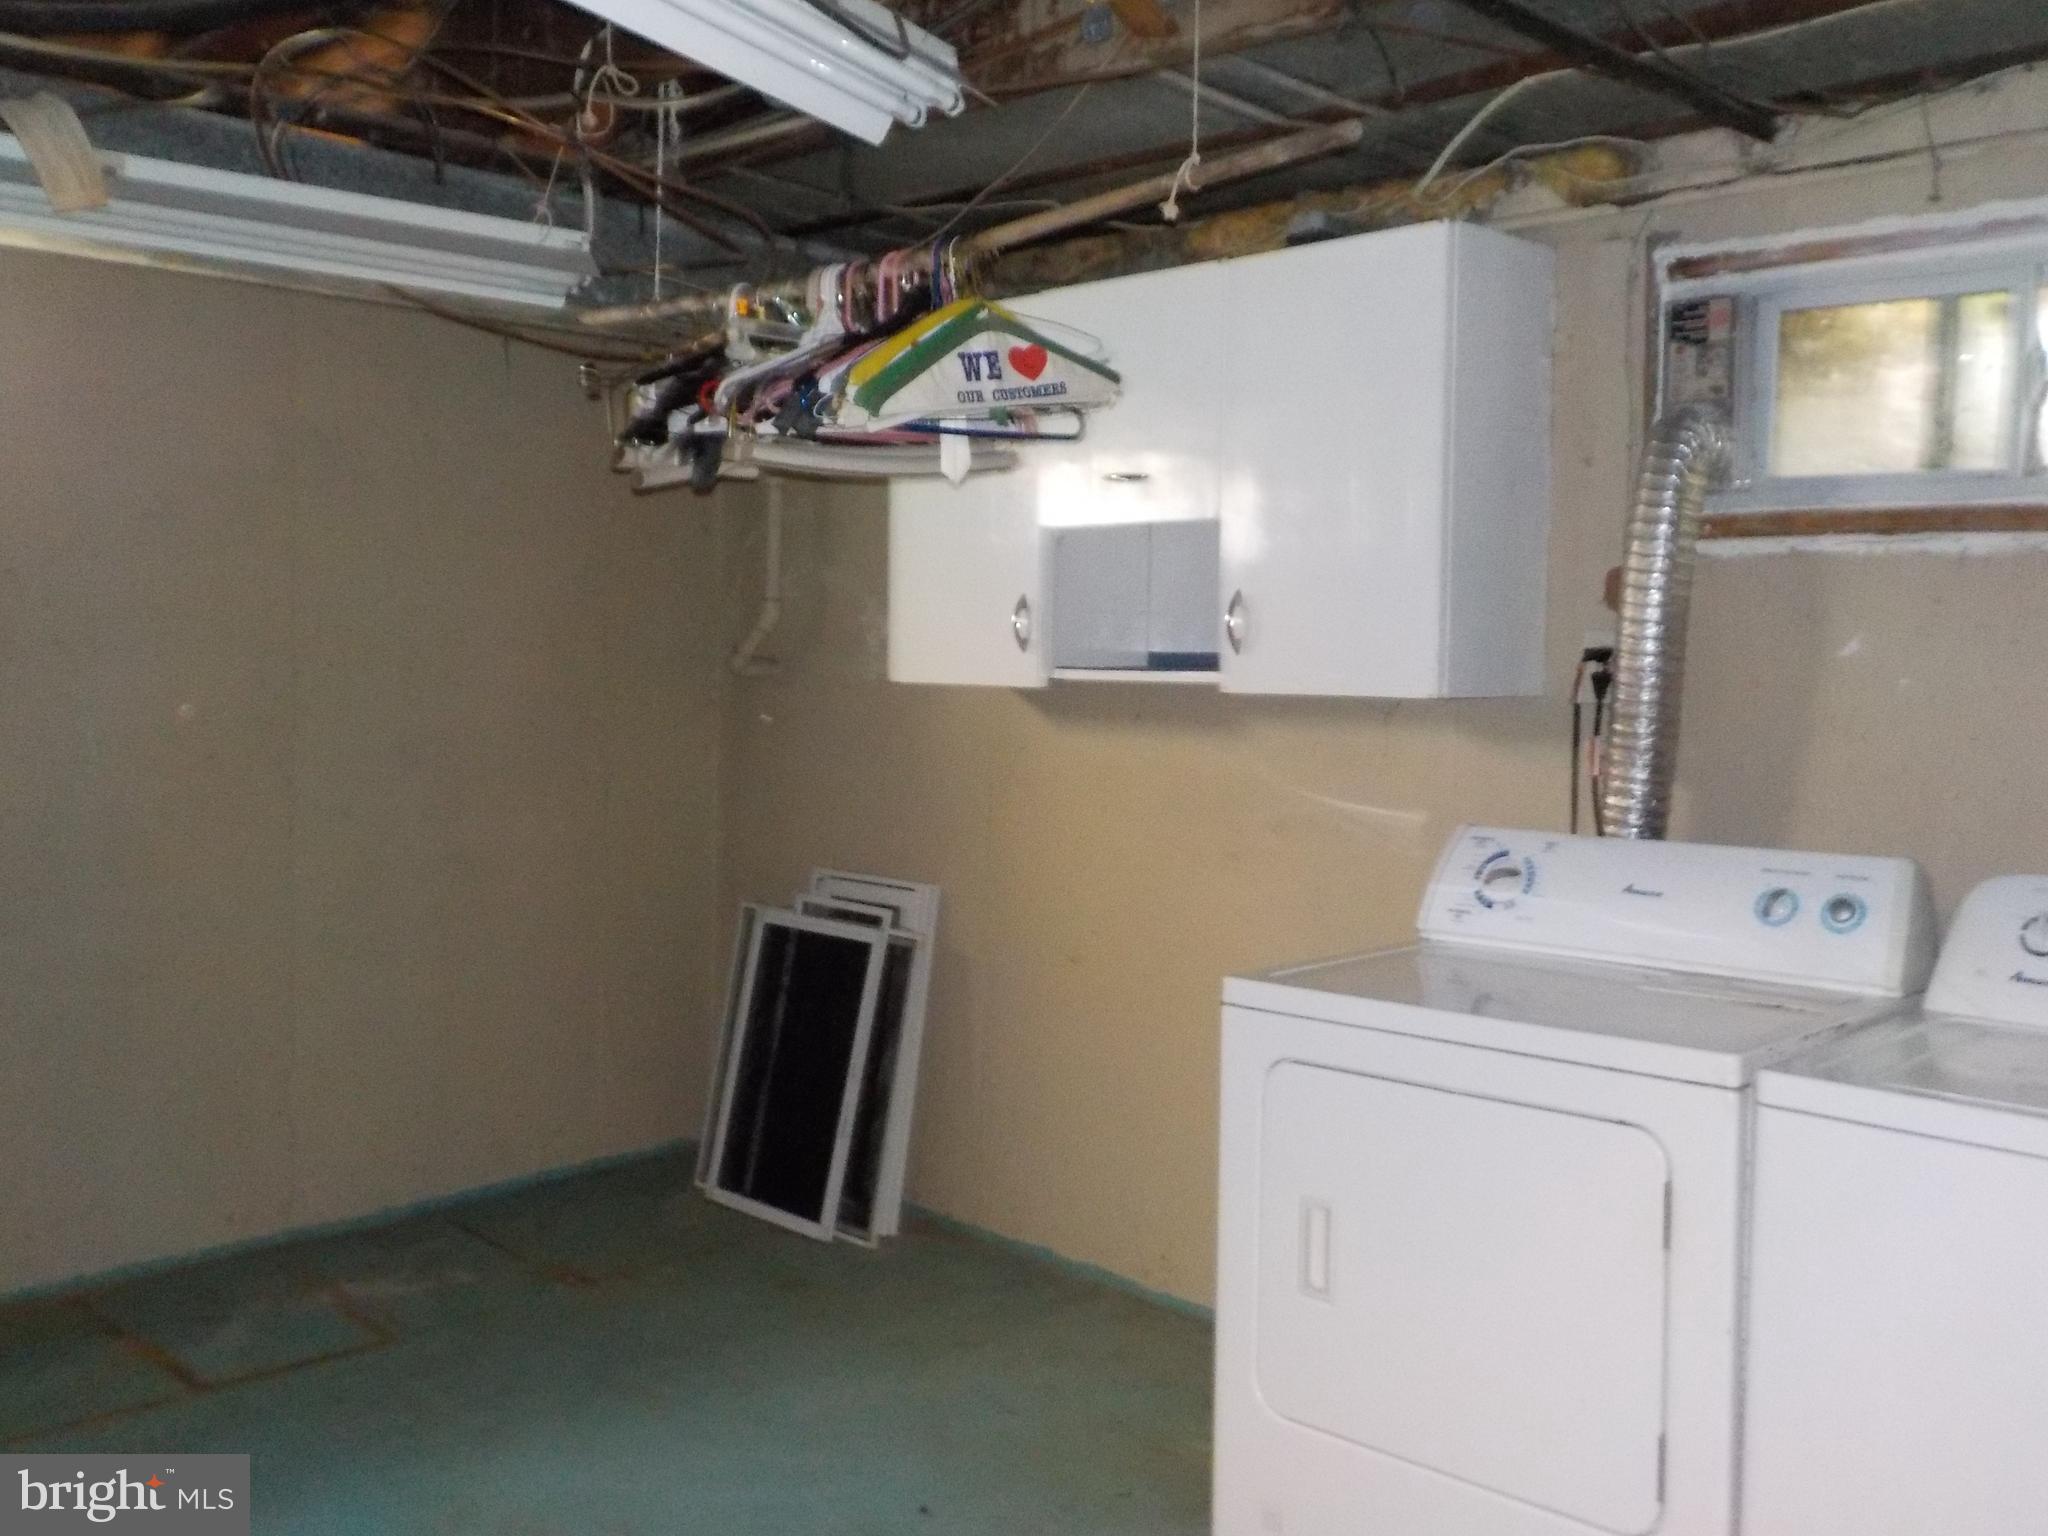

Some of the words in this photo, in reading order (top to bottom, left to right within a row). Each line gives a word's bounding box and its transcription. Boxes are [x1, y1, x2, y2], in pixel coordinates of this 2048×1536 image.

[957, 350, 1002, 382] WE
[957, 390, 984, 403] OUR
[992, 381, 1067, 402] CUSTOMERS
